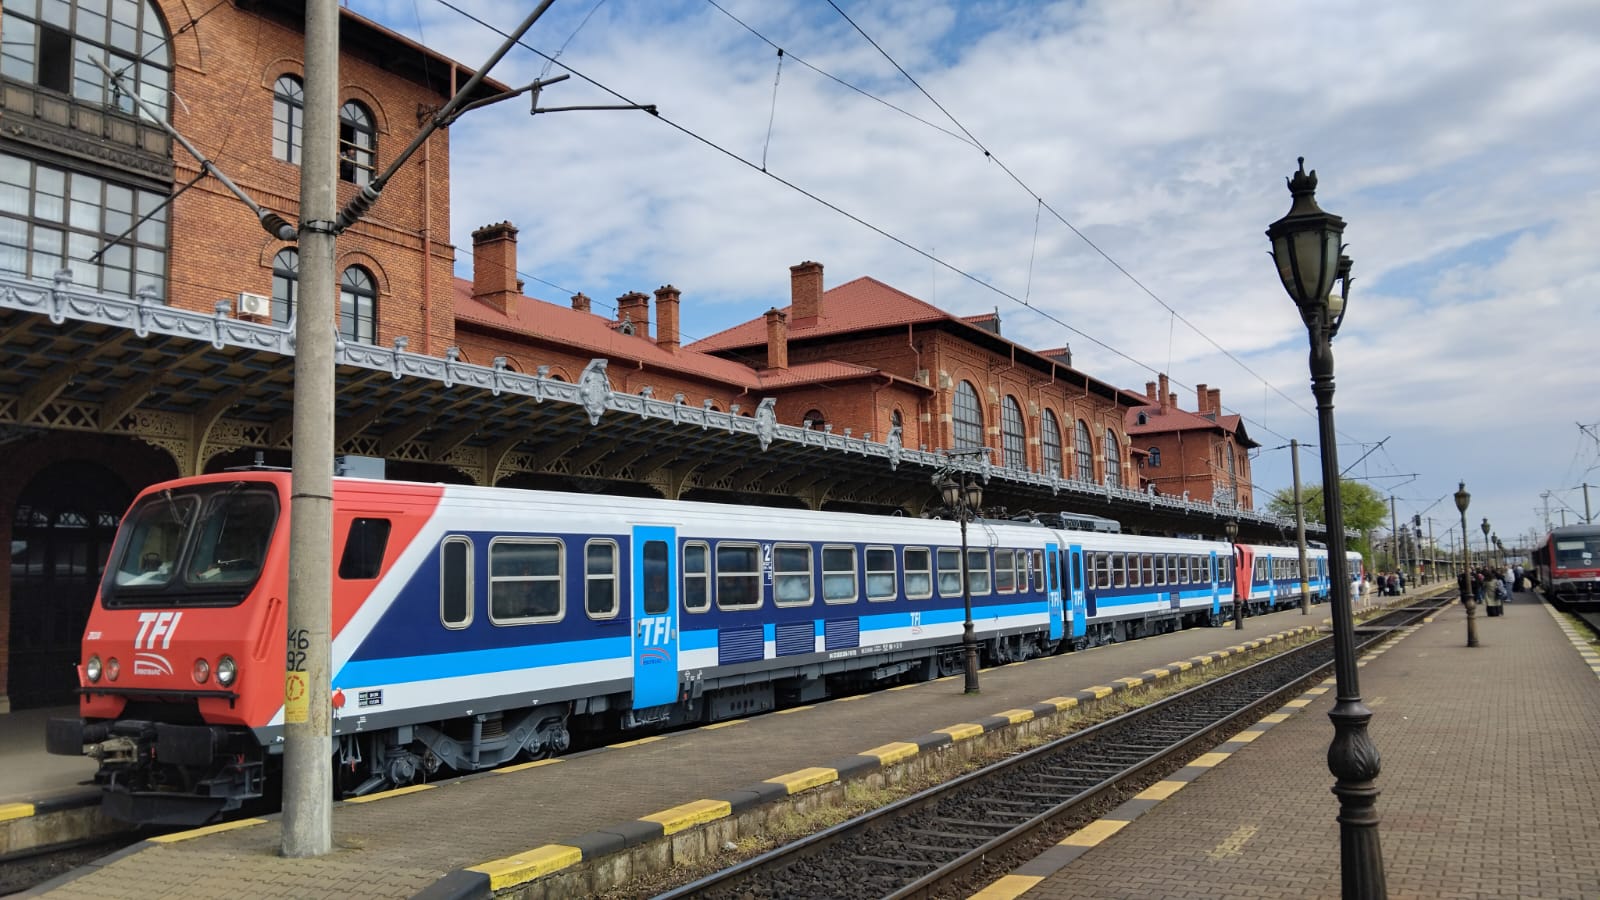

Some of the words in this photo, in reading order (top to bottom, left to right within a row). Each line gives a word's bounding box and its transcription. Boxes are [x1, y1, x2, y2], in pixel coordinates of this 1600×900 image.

[764, 545, 771, 561] 2
[134, 612, 183, 649] TFI
[640, 616, 671, 646] TFI
[287, 651, 307, 672] 92
